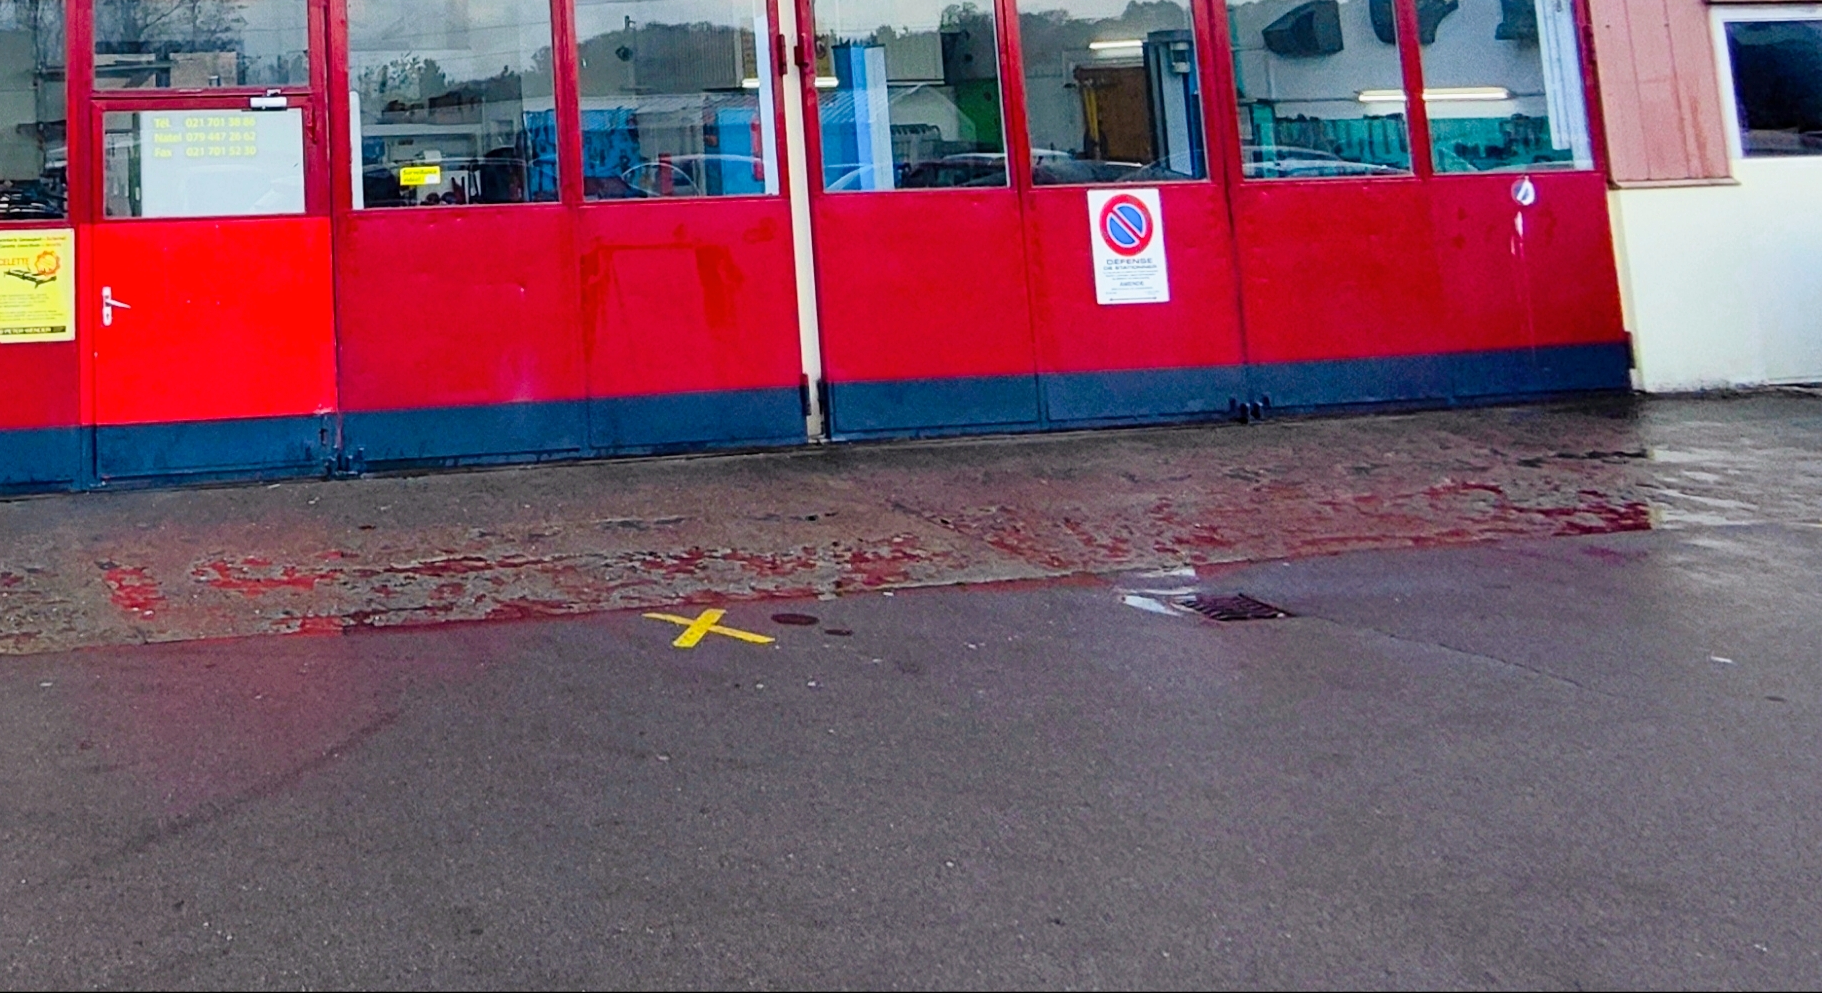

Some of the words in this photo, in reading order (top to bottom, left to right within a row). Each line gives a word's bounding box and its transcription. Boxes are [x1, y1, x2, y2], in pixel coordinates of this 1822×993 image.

[186, 117, 204, 127] 021
[207, 117, 225, 127] 701
[186, 132, 205, 142] 079
[154, 148, 172, 157] Fax
[186, 147, 204, 156] 021
[208, 147, 225, 156] 701
